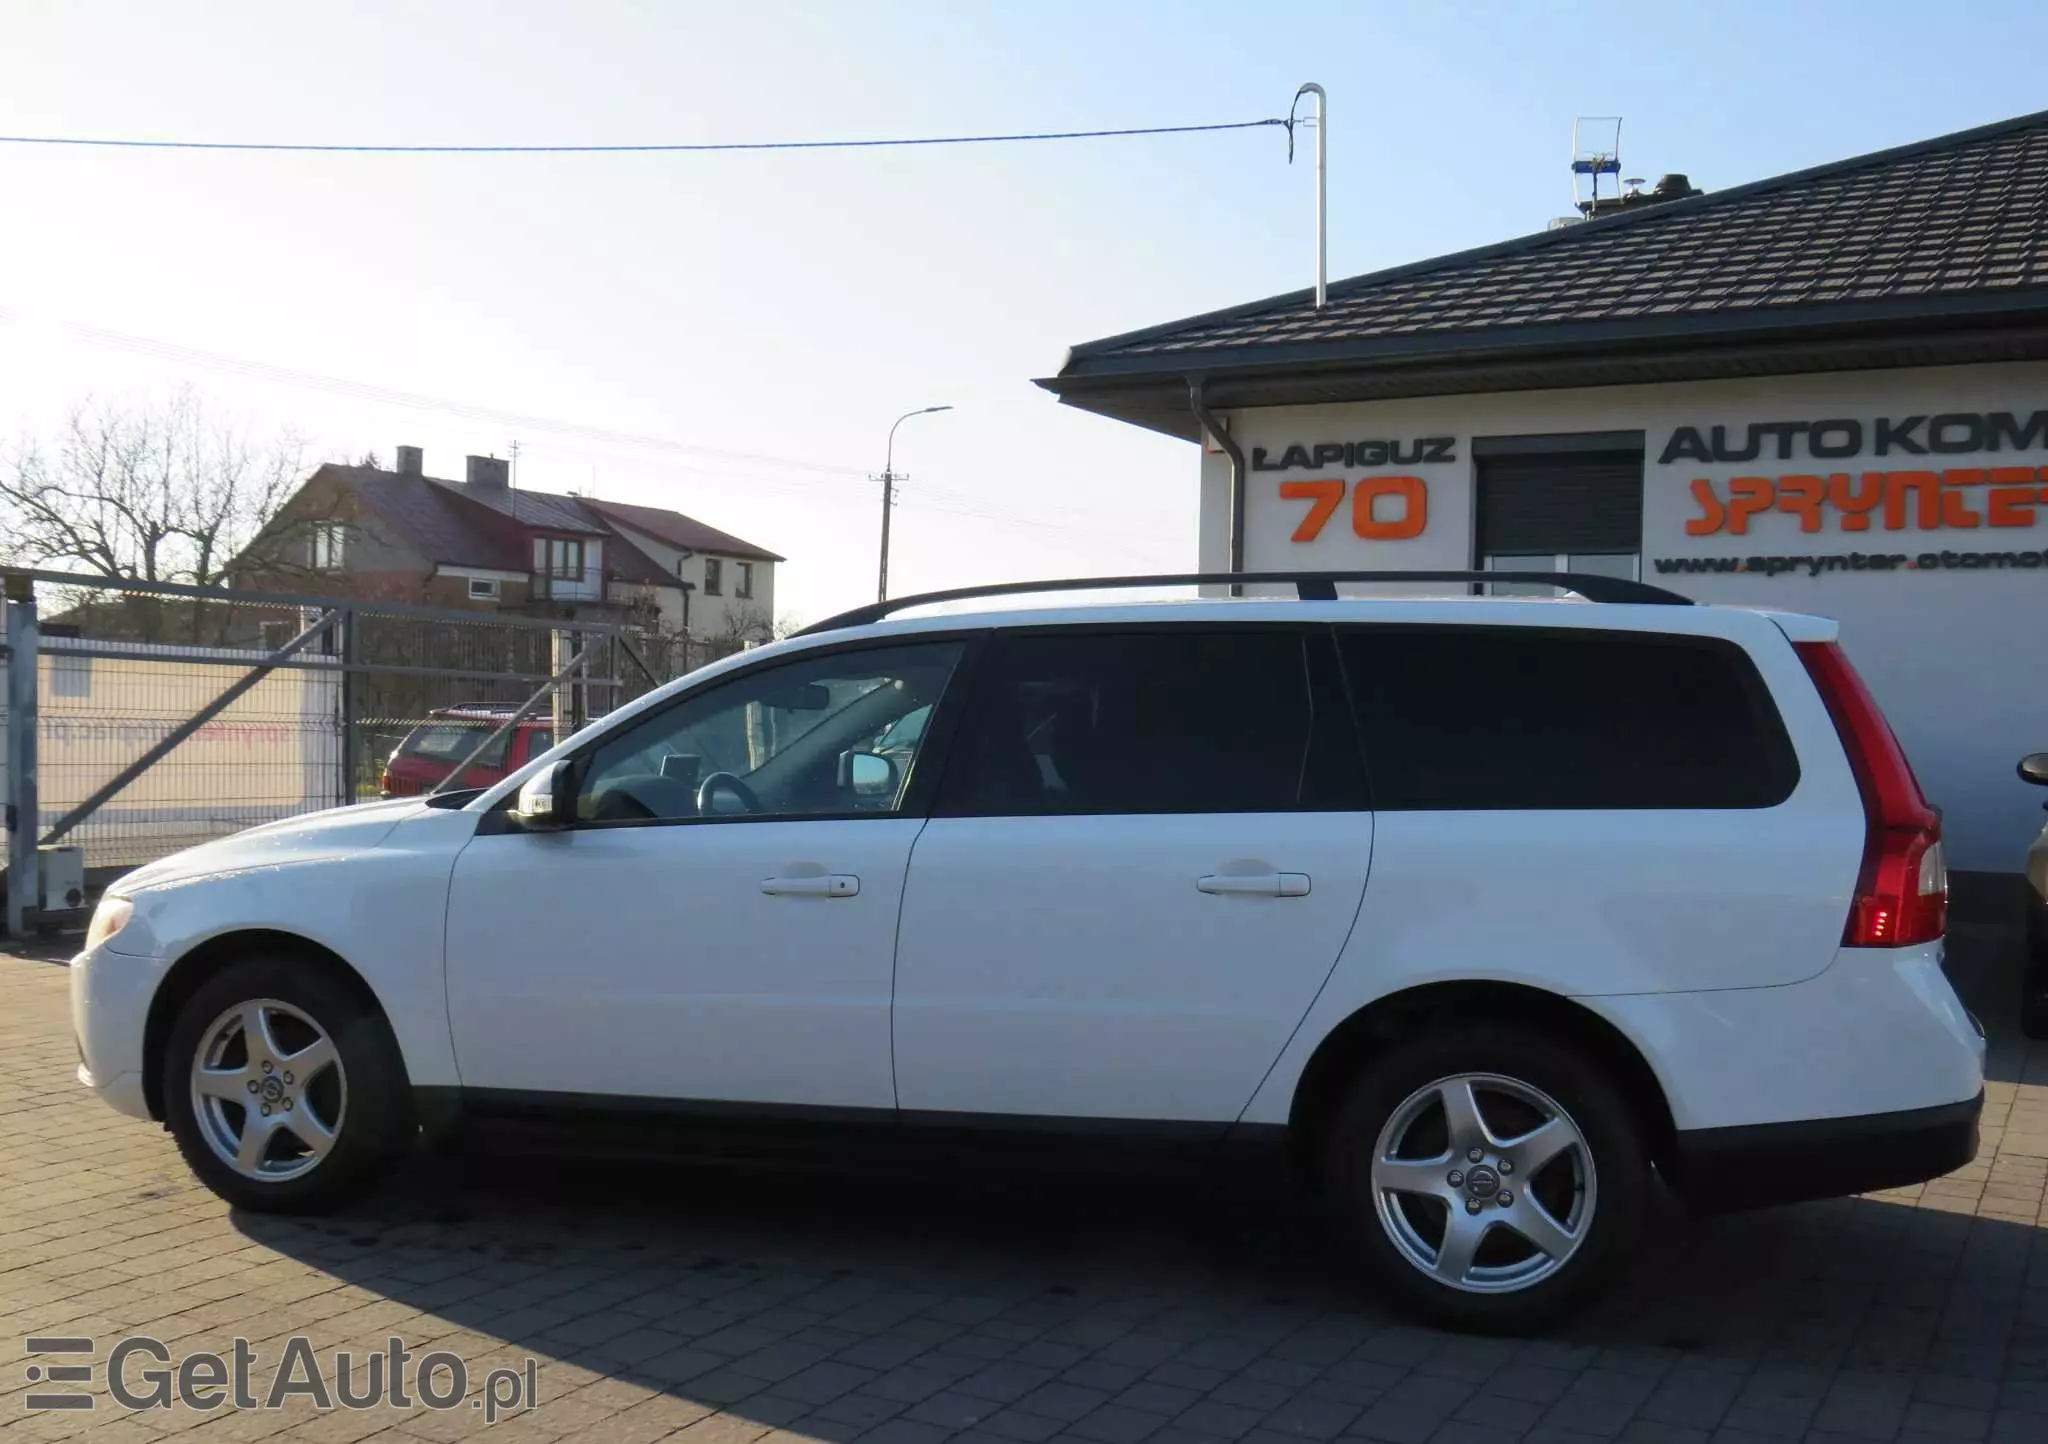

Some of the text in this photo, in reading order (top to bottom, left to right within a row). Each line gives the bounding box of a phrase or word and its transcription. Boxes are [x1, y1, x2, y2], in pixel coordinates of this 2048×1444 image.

[1658, 418, 1863, 464] AUTO
[1279, 476, 1427, 543] 70
[1685, 466, 2048, 536] SPRYNTE
[1655, 550, 2048, 577] www.sprynter.otomo
